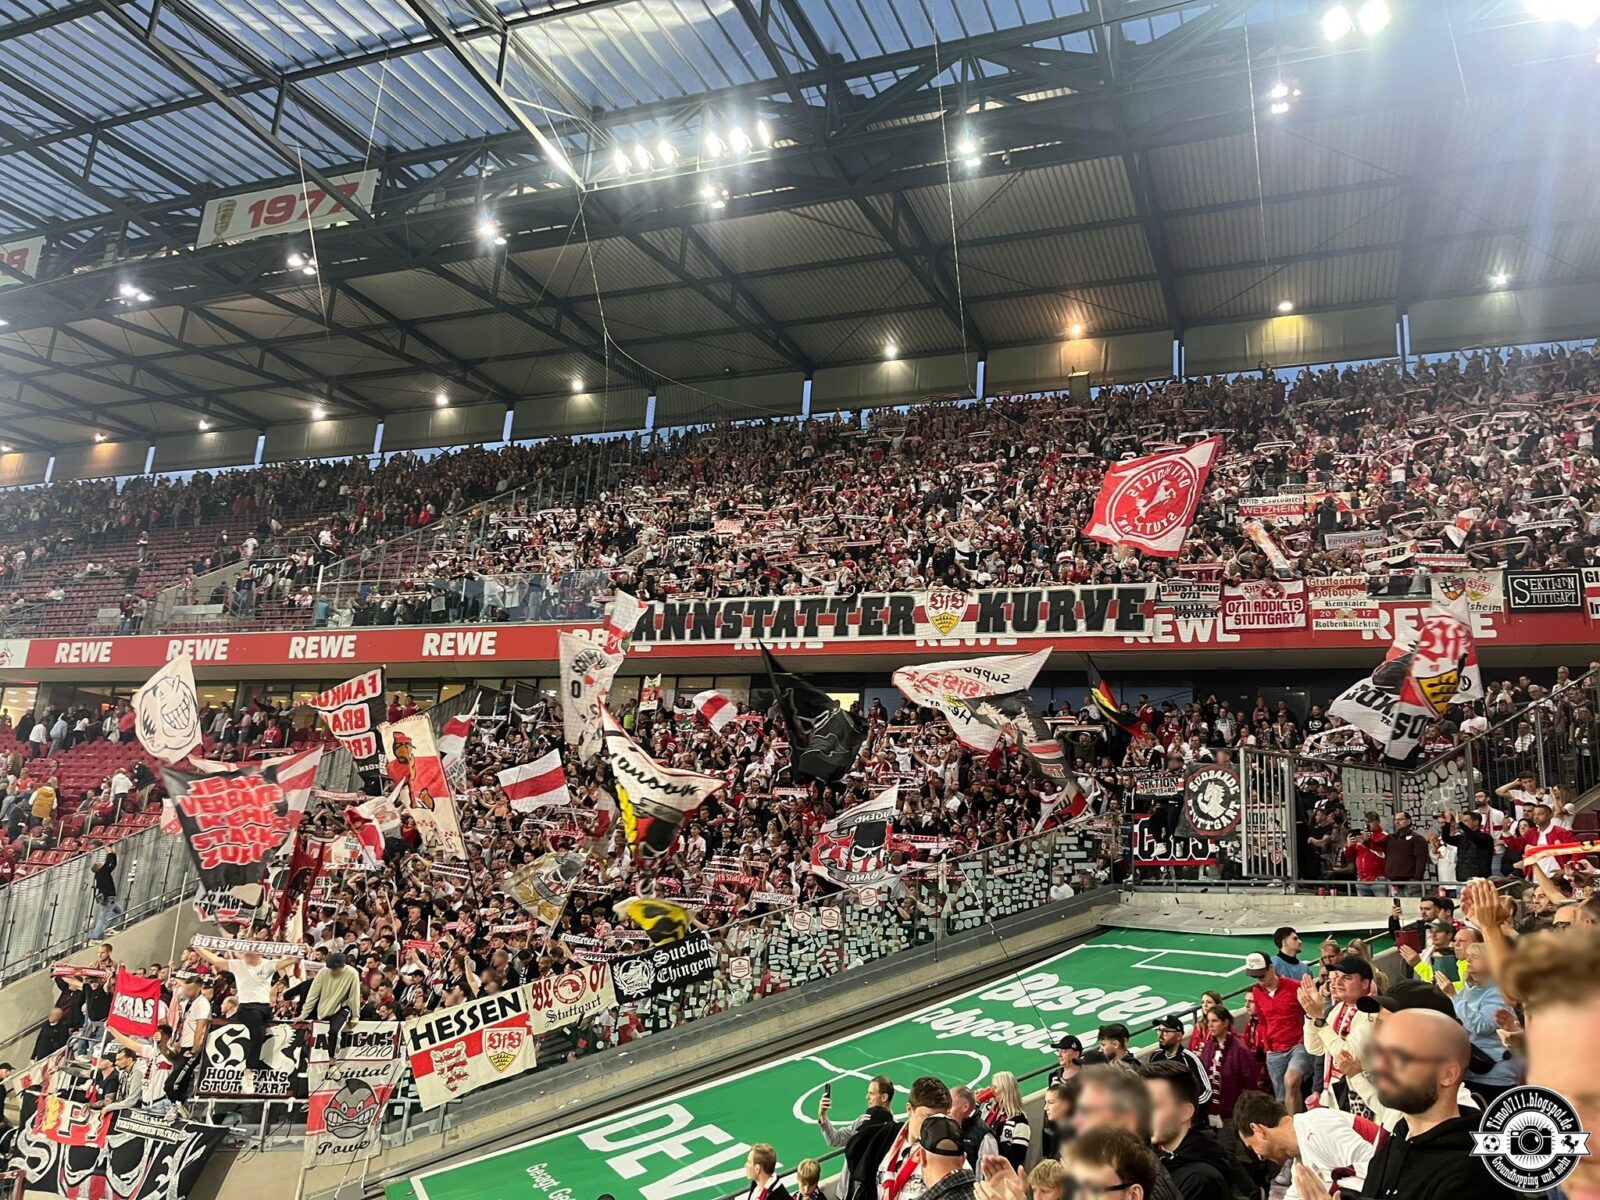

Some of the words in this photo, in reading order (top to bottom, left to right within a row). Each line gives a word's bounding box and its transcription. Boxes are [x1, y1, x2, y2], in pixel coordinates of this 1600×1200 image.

[248, 182, 360, 229] 1977
[1242, 505, 1300, 514] WELZHEIM
[1180, 592, 1200, 600] 0711
[1228, 600, 1251, 614] 0711
[1253, 599, 1302, 613] ADDICTS
[632, 596, 916, 641] ANNSTATTER
[976, 587, 1147, 634] KURVE
[1175, 611, 1219, 620] POWER
[1234, 611, 1298, 626] STUTTGART
[1320, 609, 1332, 618] 20
[1362, 609, 1373, 617] 17
[1361, 607, 1498, 641] REE
[54, 641, 114, 664] REWE
[165, 637, 231, 662] REWE
[288, 634, 358, 660] REWE
[421, 631, 498, 657] REWE
[653, 937, 709, 968] Suebia
[656, 956, 716, 984] Ehingen
[410, 992, 522, 1051] HESSEN
[545, 995, 603, 1028] Stuttgart
[354, 1046, 393, 1058] 2010
[199, 1080, 291, 1096] STUTGART
[206, 1069, 290, 1083] HOOLGANS
